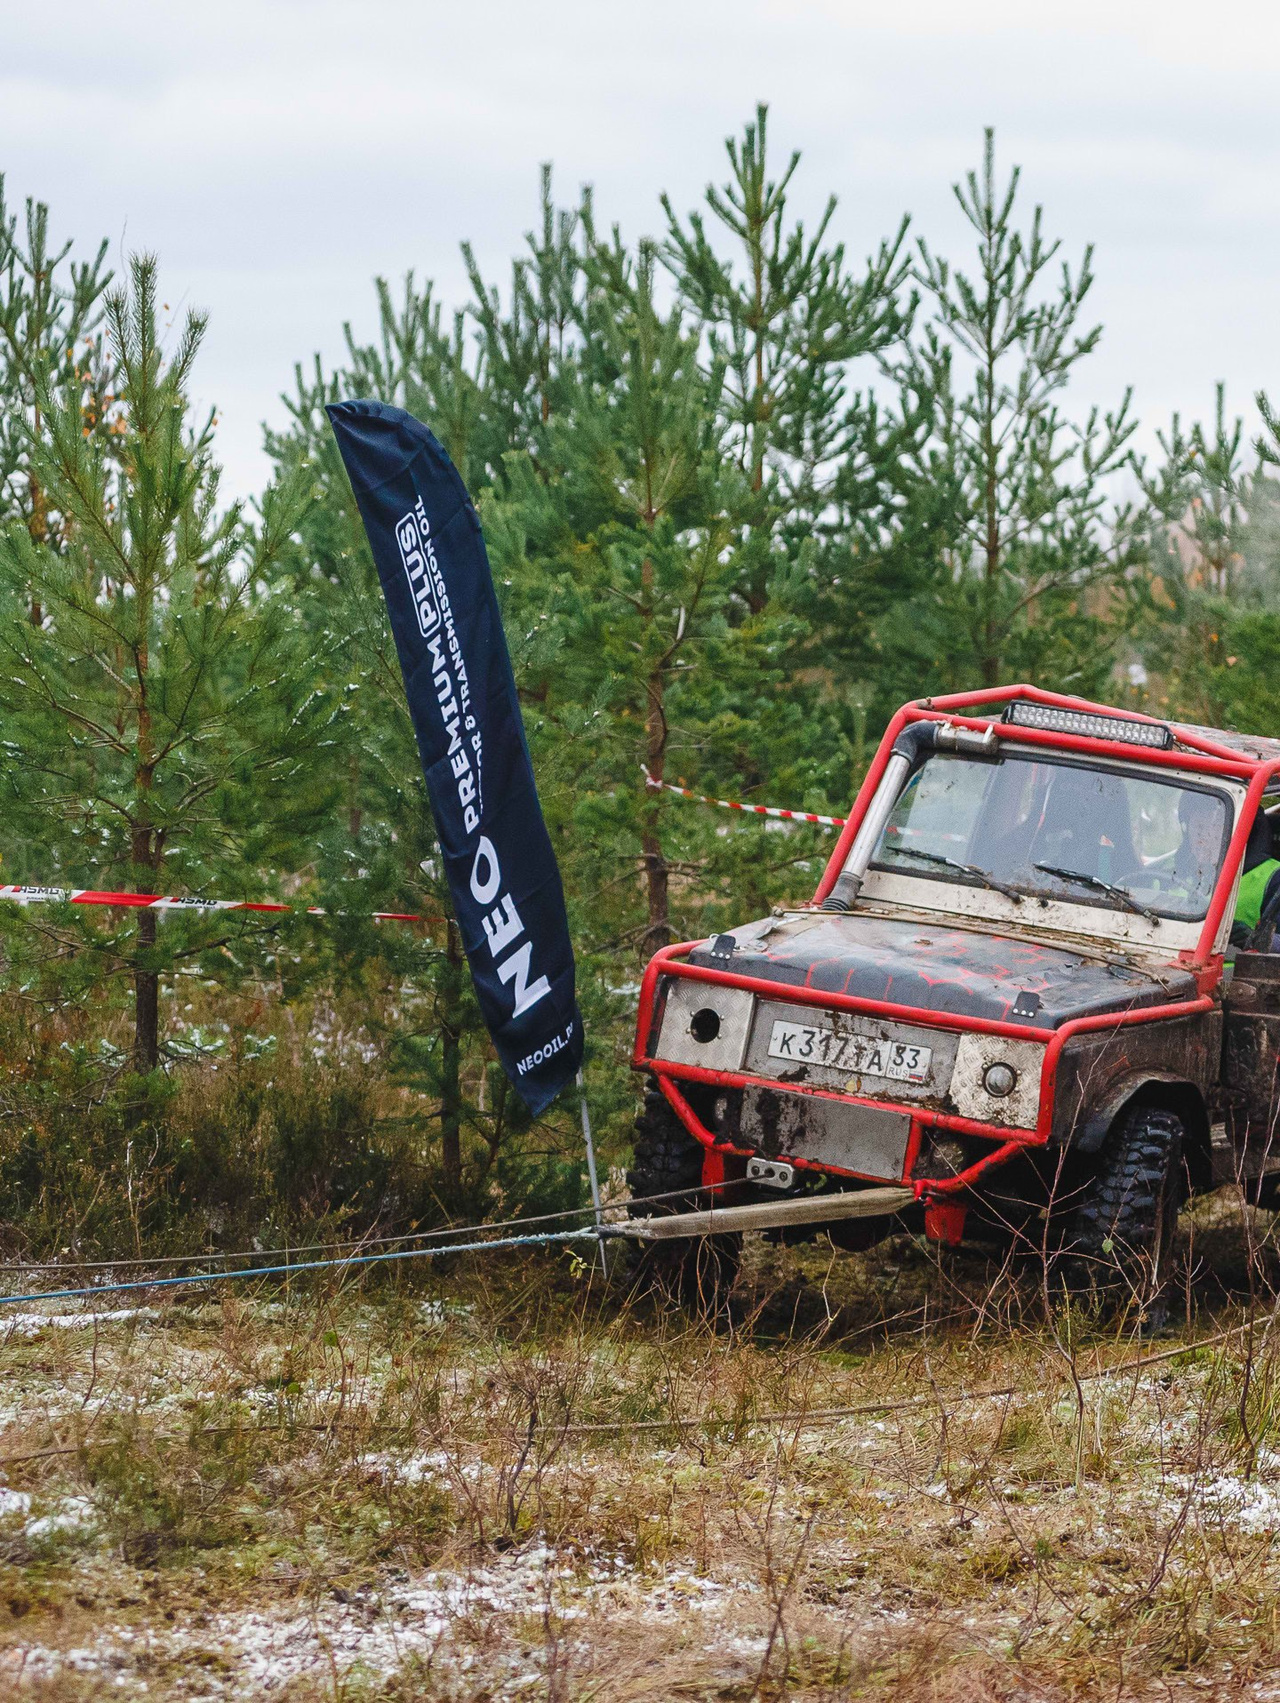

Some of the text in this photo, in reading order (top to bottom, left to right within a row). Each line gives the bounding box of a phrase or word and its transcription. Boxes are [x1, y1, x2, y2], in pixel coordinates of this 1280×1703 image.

[414, 494, 430, 536] OIL
[425, 538, 471, 714] TRANSMISSION
[400, 522, 552, 1019] NEO PREMIUM PLUS
